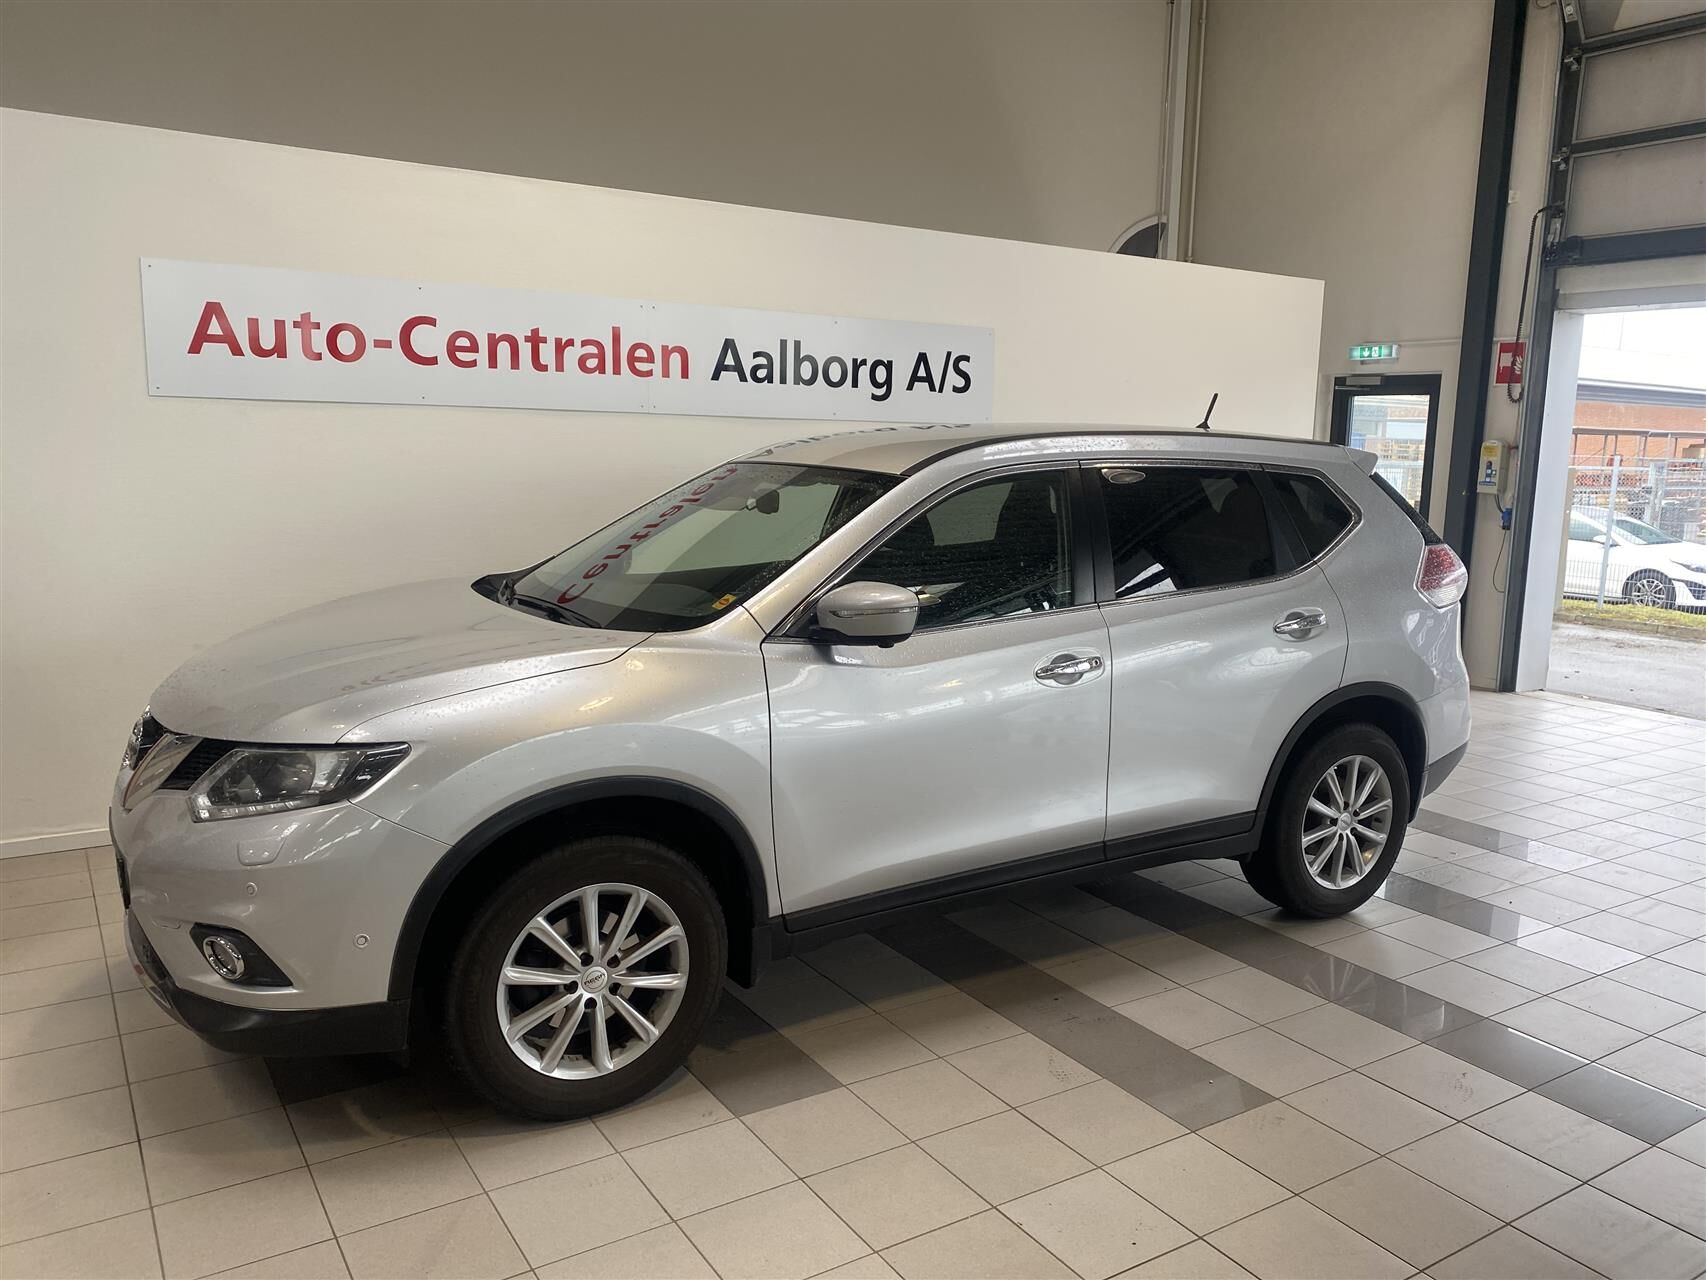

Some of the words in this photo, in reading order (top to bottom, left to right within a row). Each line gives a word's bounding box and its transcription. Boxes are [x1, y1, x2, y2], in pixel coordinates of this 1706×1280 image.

[188, 302, 690, 379] Auto-Centralen
[710, 337, 895, 402] Aalborg
[905, 350, 973, 394] A/S
